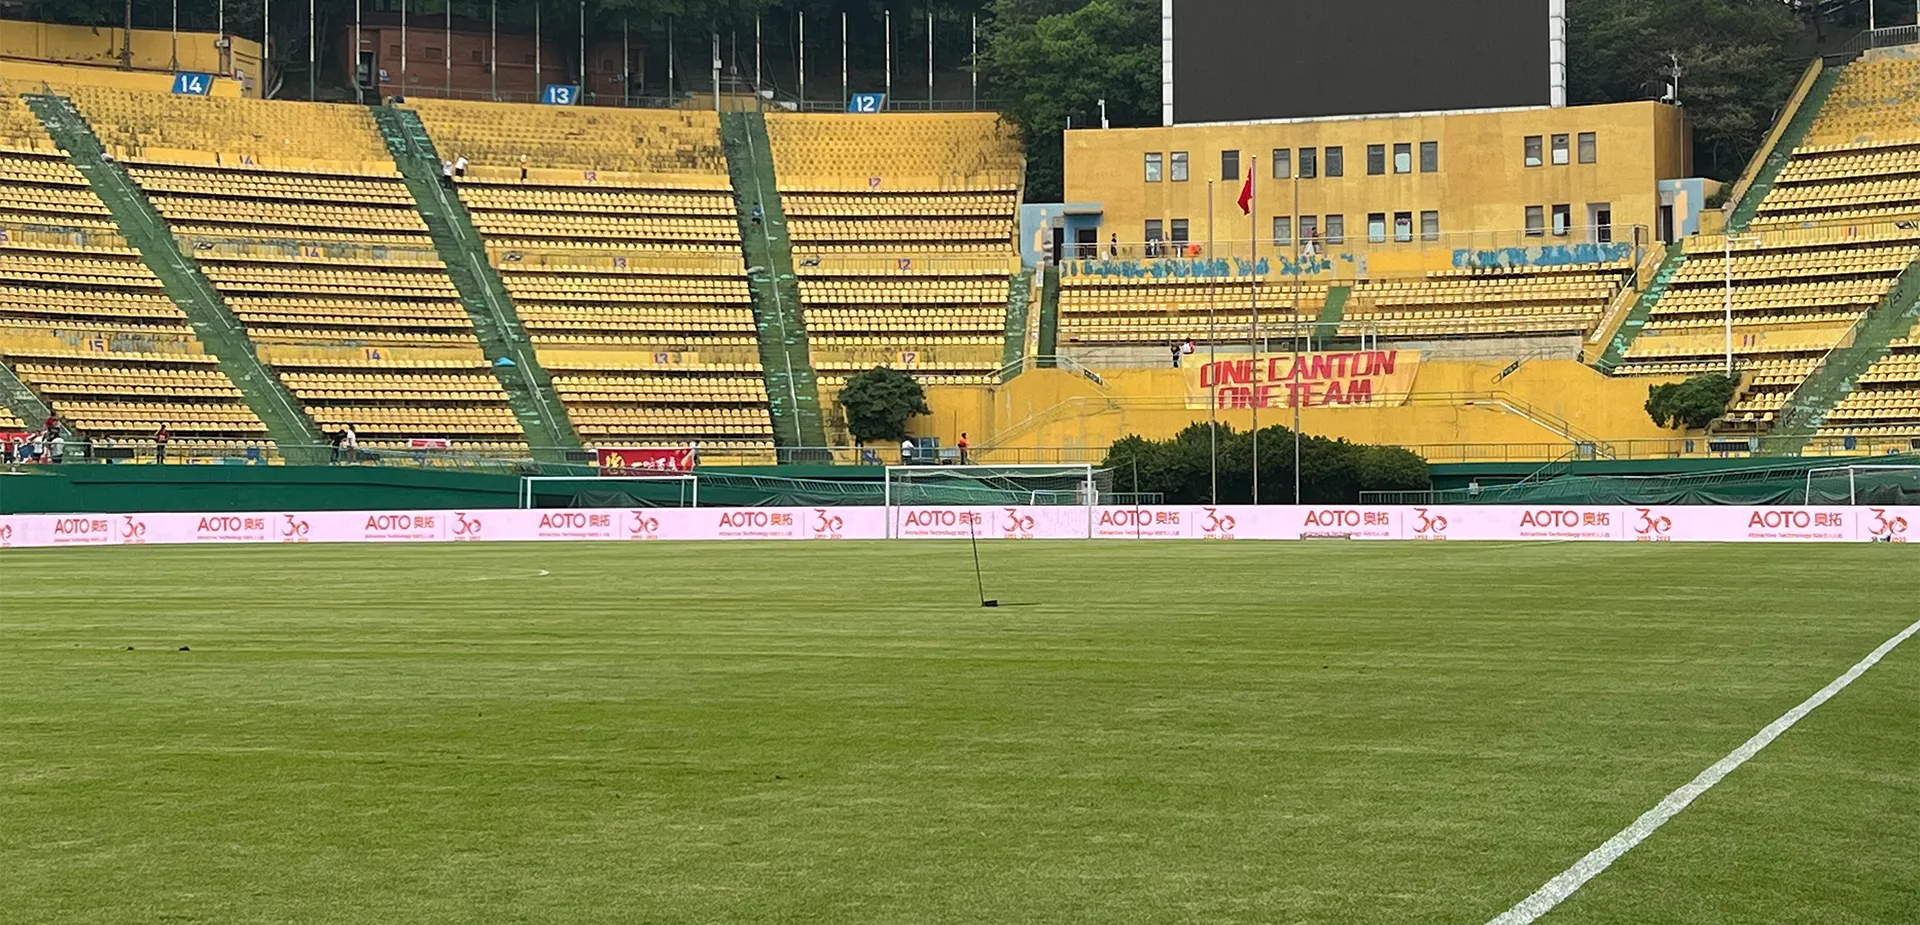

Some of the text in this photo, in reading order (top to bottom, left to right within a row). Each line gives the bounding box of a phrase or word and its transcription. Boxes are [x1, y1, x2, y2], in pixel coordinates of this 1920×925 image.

[182, 75, 202, 94] 14
[550, 87, 569, 104] 13
[857, 96, 875, 113] 12
[898, 258, 911, 270] 12
[89, 340, 105, 352] 15
[366, 349, 381, 361] 14
[655, 353, 668, 364] 13
[902, 353, 915, 364] 12
[1200, 351, 1397, 388] ONE CANTON
[1218, 379, 1372, 409] ONE TEAM
[54, 518, 90, 534] AOTO
[197, 516, 242, 532] AOTO
[365, 515, 411, 530] AOTO
[539, 513, 586, 528] AOTO
[719, 511, 793, 527] AOTO 奥拓
[905, 510, 956, 526] AOTO
[1100, 510, 1180, 526] AOTO 奥拓
[1304, 510, 1389, 526] AOTO 奥拓
[1520, 510, 1611, 527] AOTO 奥拓
[1748, 510, 1843, 528] AOTO 奥拓
